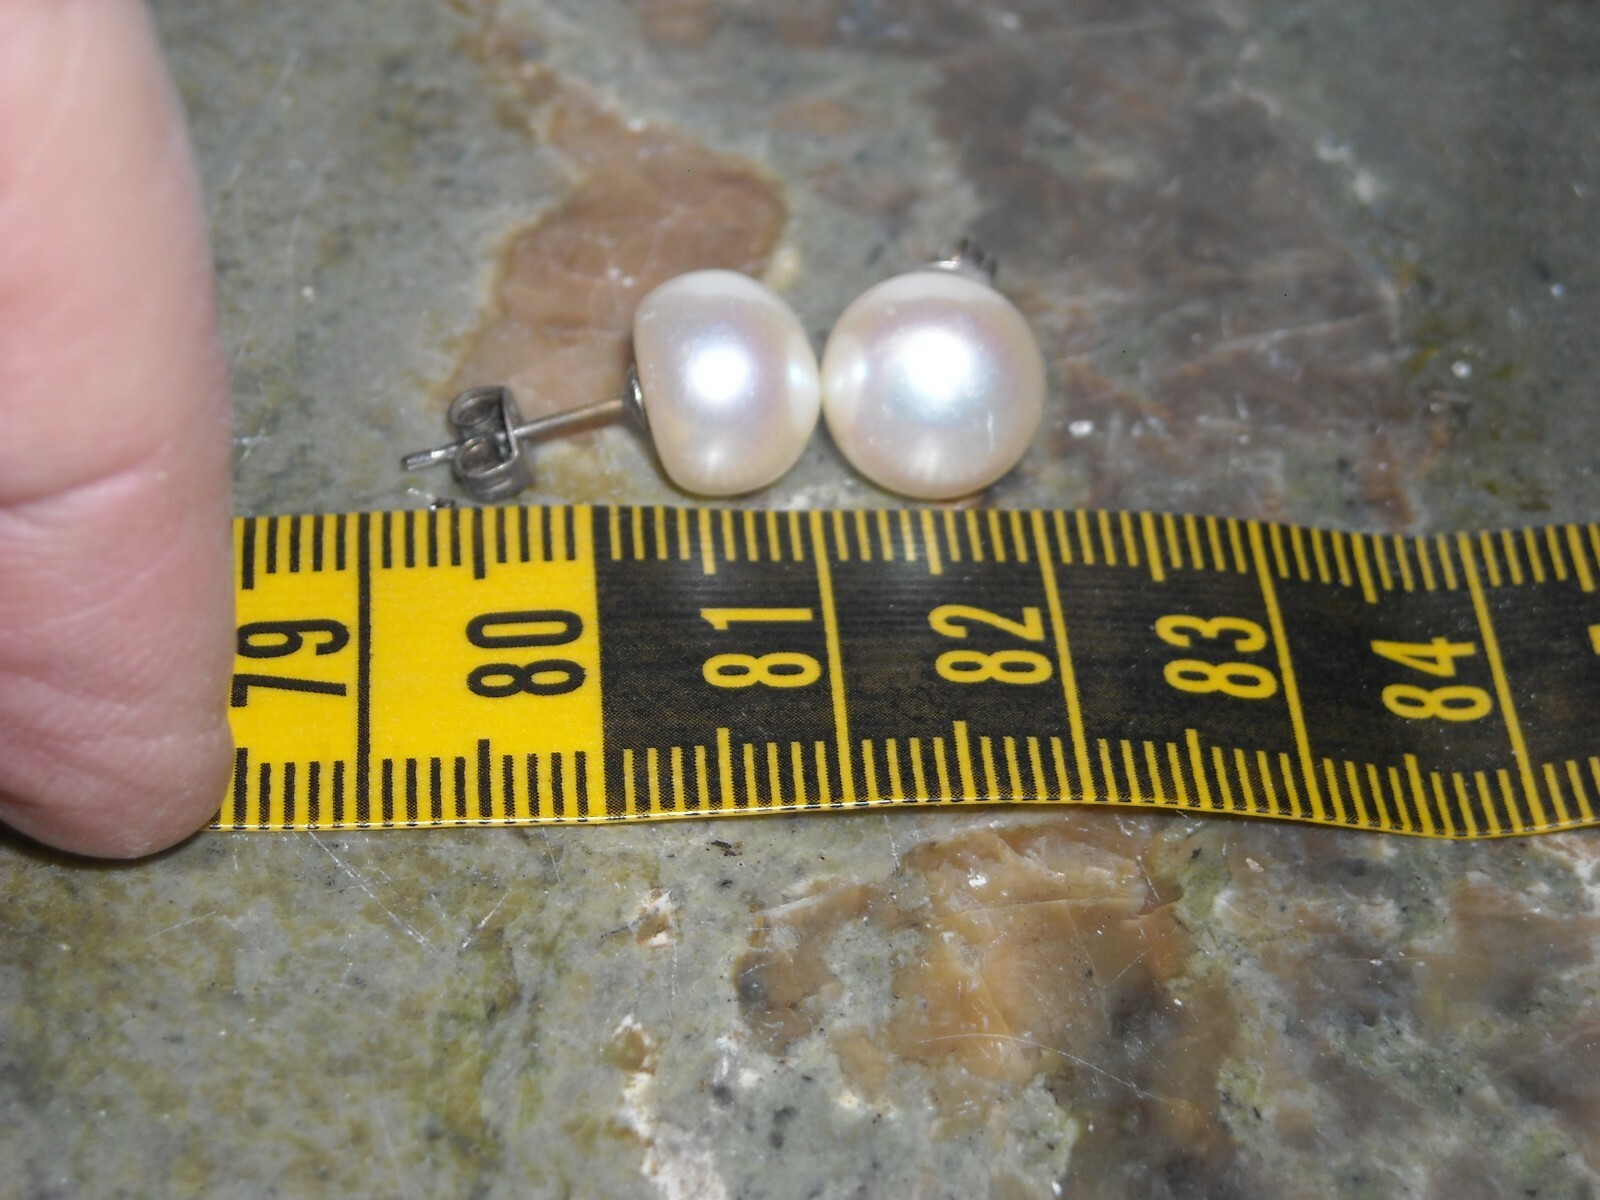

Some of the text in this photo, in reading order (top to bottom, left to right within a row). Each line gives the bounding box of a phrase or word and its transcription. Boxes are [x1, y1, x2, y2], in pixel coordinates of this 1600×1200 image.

[230, 618, 350, 708] 79
[465, 609, 587, 698] 80
[700, 607, 822, 690] 81
[928, 604, 1053, 685] 82
[1154, 614, 1279, 699] 83
[1370, 636, 1493, 722] 84
